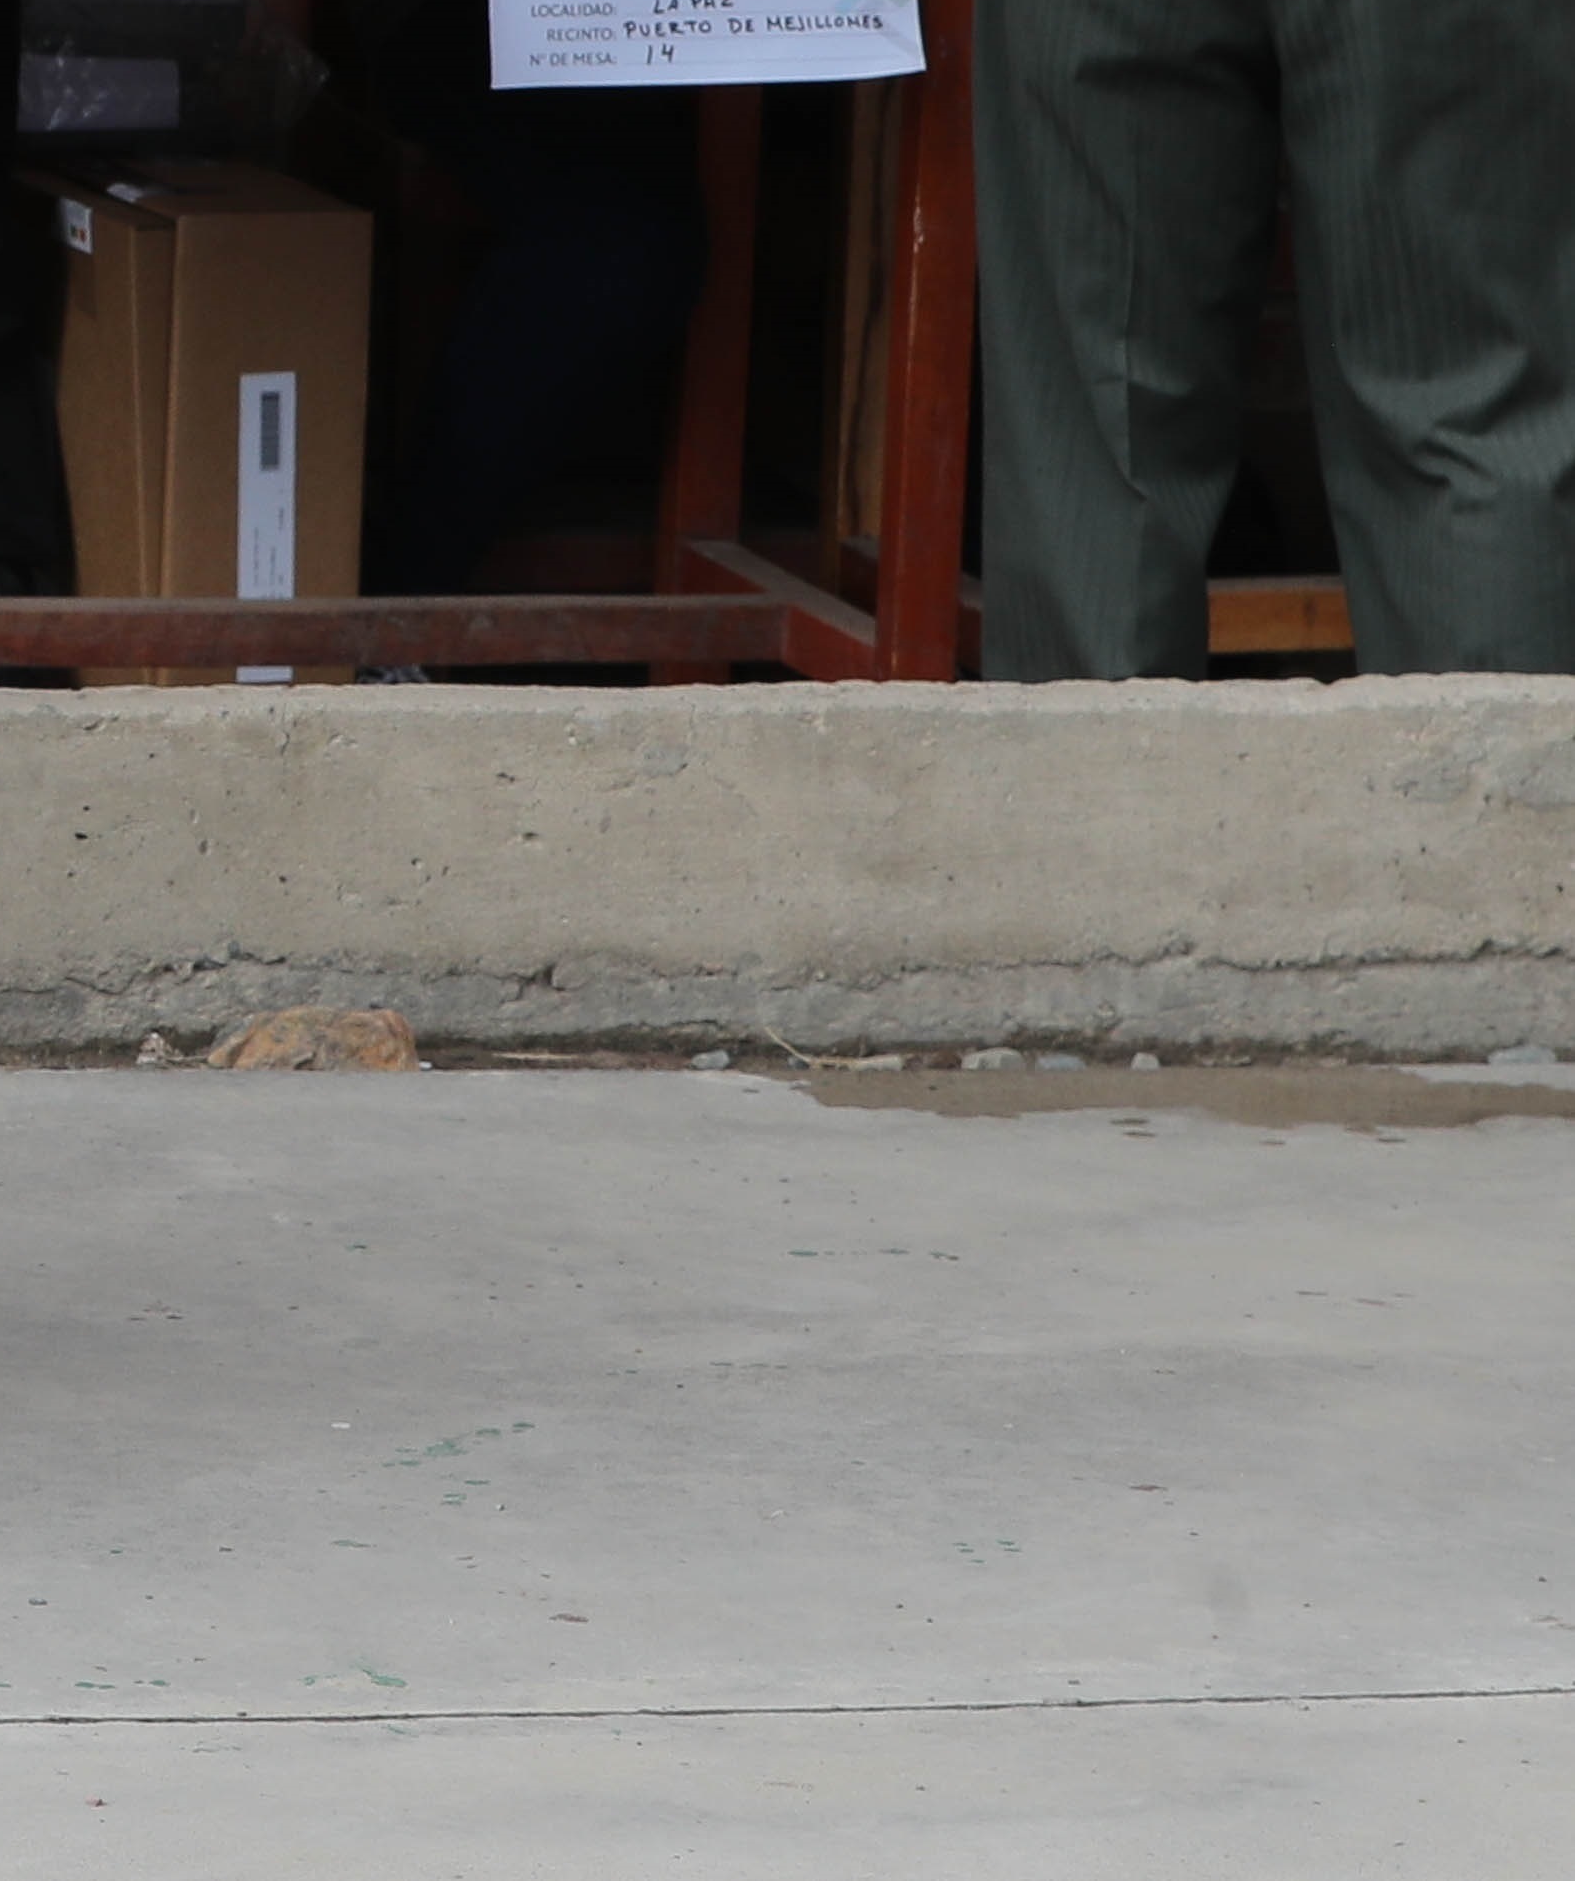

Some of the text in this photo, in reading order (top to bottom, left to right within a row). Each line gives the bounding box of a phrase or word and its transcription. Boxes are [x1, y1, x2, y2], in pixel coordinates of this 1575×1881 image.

[530, 4, 618, 19] LOCALIDAD:
[546, 13, 884, 43] RECINTO: PUERTO DE MEJILLONES
[550, 51, 570, 67] DE
[572, 51, 618, 67] MESA:
[645, 44, 675, 66] 14
